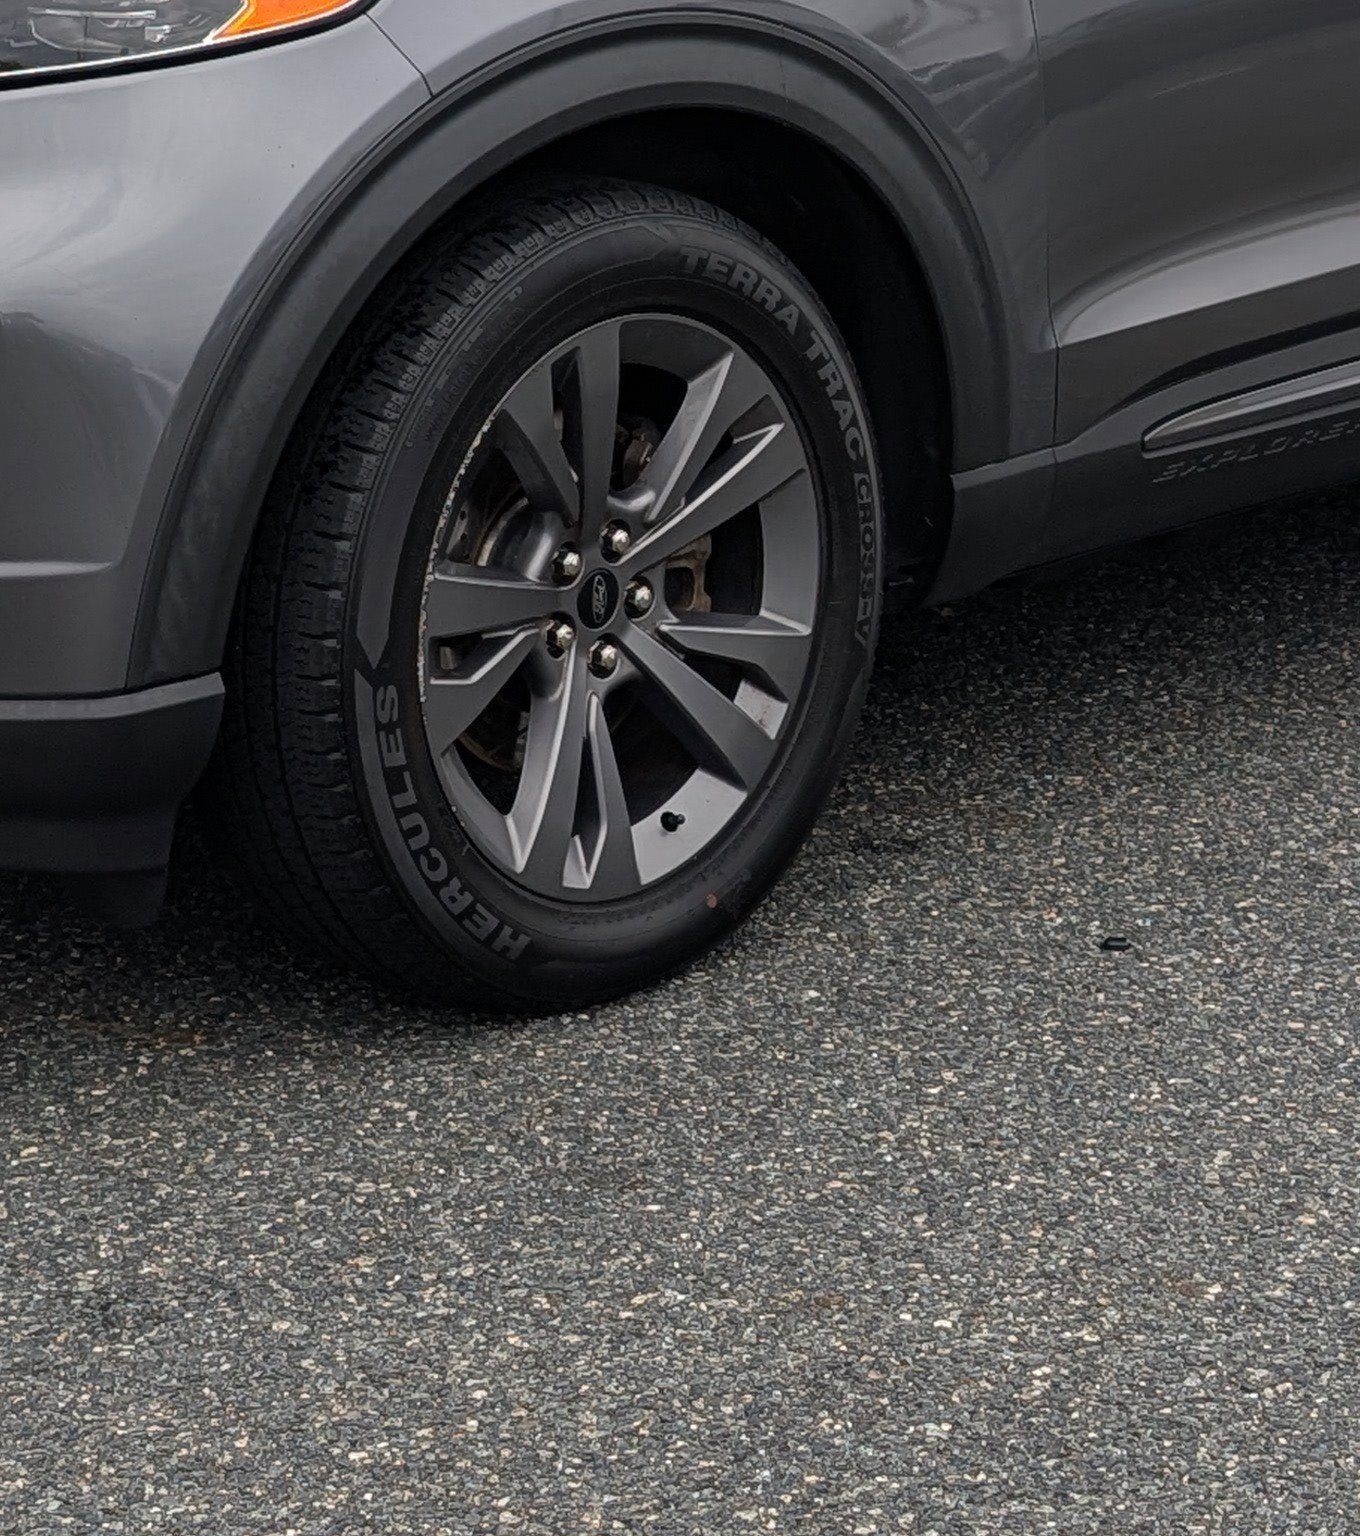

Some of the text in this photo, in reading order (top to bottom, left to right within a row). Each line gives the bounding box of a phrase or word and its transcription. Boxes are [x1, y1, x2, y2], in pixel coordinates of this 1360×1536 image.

[676, 243, 800, 335] TERRA
[803, 329, 866, 462] TRAC
[375, 684, 533, 961] HERCULES
